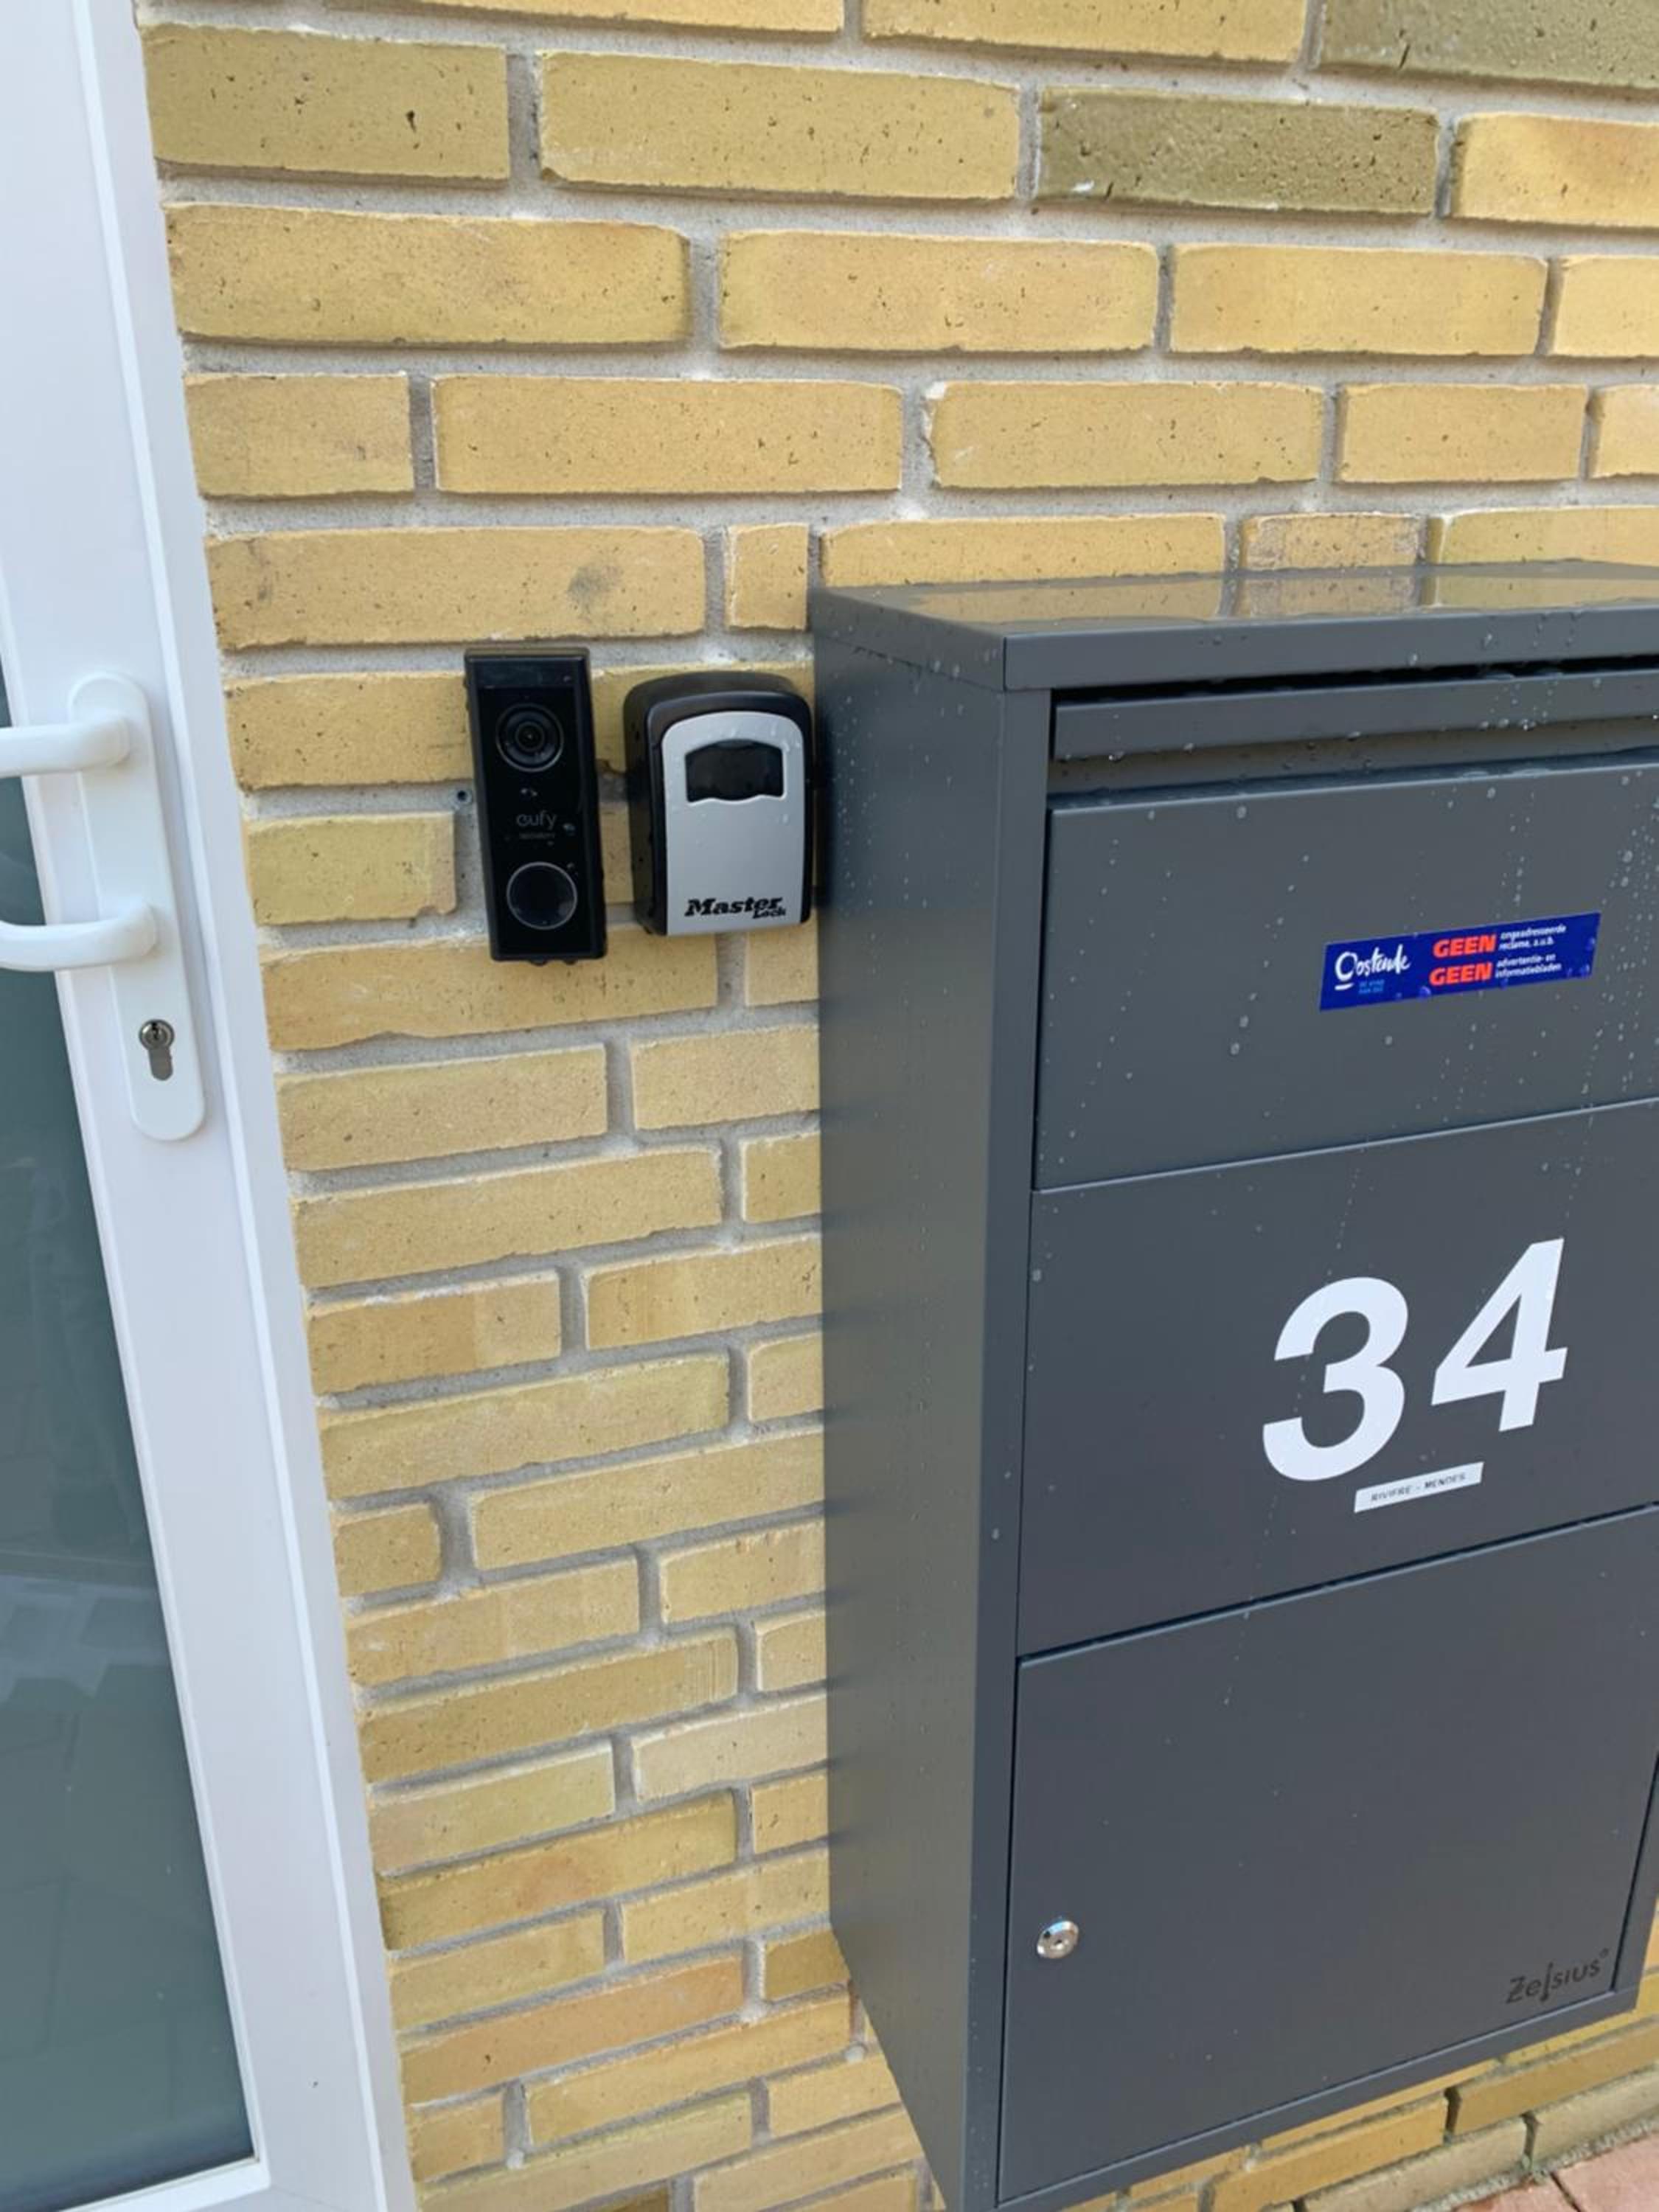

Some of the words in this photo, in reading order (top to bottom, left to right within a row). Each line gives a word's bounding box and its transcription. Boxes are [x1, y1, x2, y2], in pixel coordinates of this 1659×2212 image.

[517, 810, 557, 831] eufy
[684, 897, 783, 917] Master
[752, 906, 787, 919] Lock
[1433, 933, 1497, 958] GEEN
[1429, 961, 1493, 986] GEEN
[1262, 1237, 1568, 1481] 34
